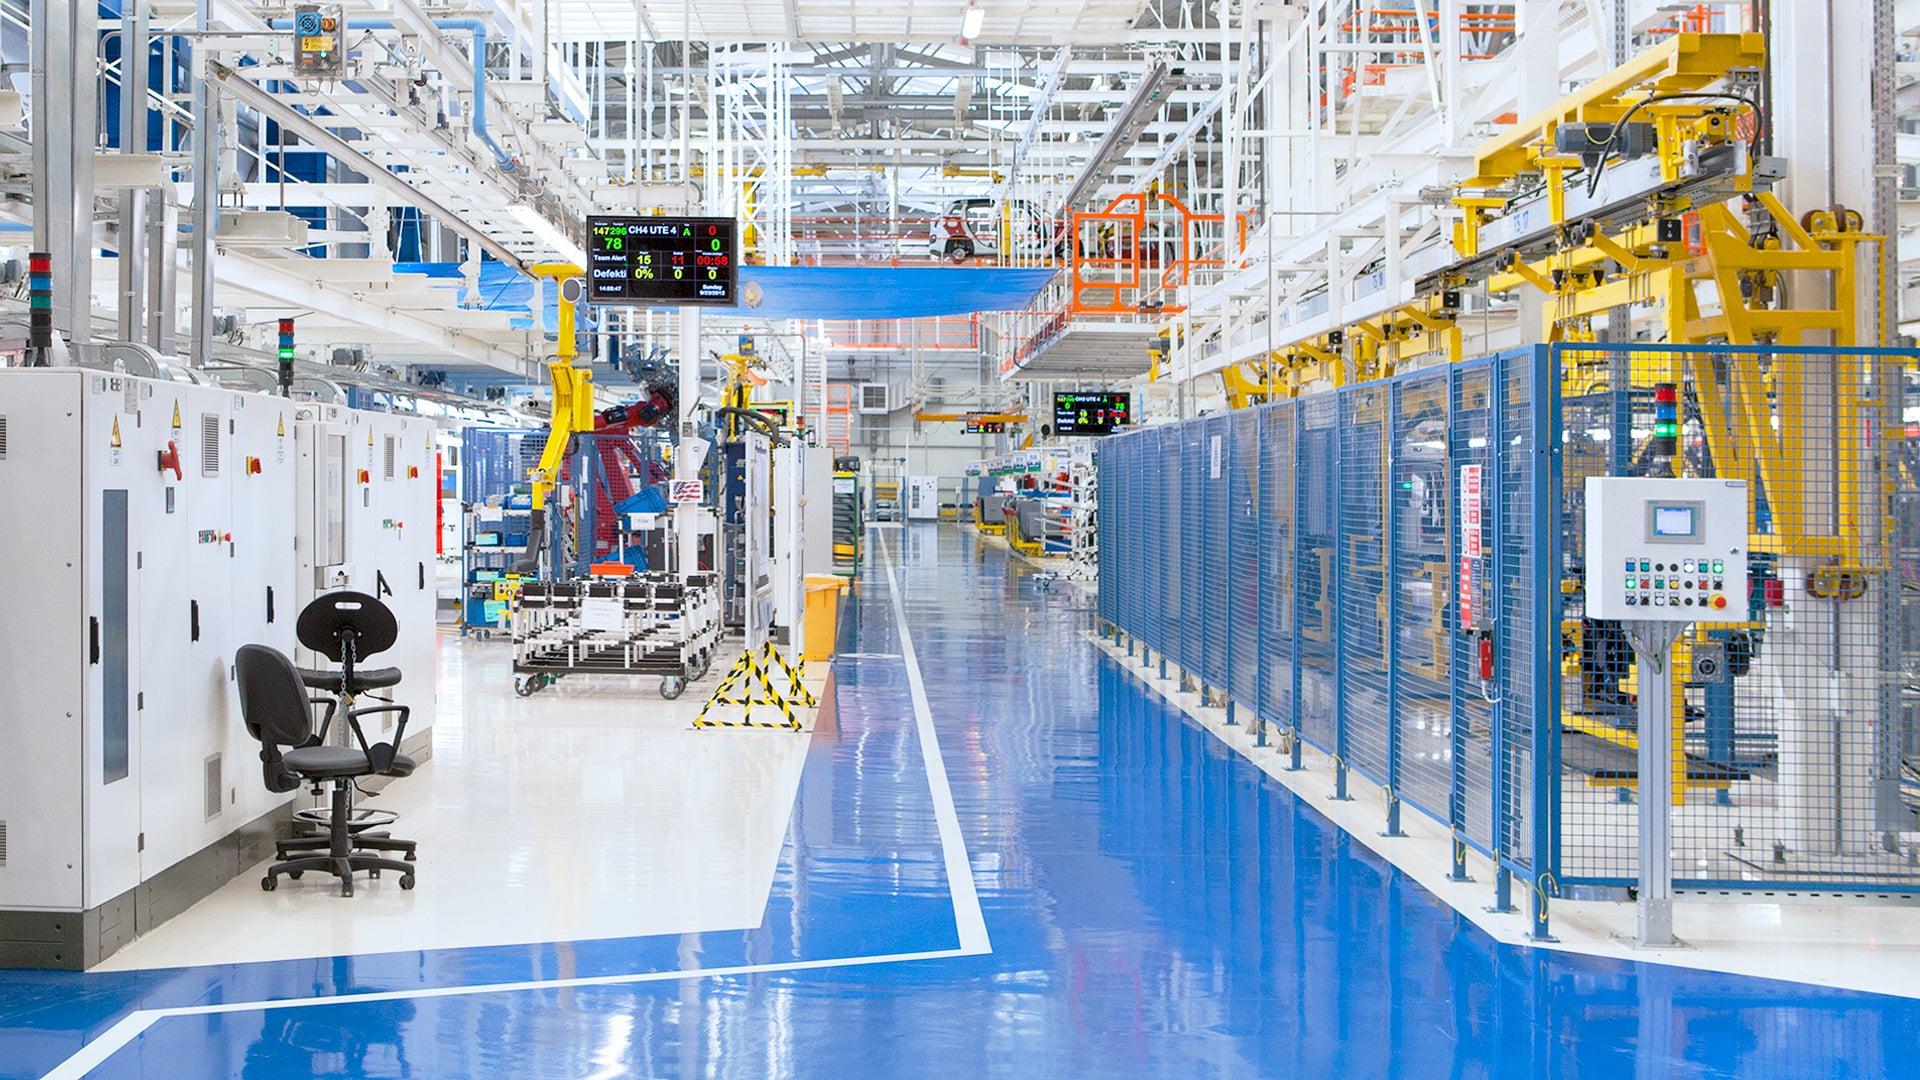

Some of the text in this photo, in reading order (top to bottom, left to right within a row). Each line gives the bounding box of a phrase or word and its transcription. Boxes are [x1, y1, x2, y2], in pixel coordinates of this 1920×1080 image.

[593, 227, 610, 236] 147
[610, 227, 628, 236] 296
[628, 225, 677, 235] CH4 UTE 4
[682, 227, 691, 236] A
[708, 225, 717, 236] 0
[604, 237, 622, 250] 78
[711, 239, 721, 251] 0
[637, 255, 651, 265] 15
[671, 255, 685, 265] 11
[593, 269, 627, 278] Defekti
[634, 268, 654, 279] 0%
[674, 269, 682, 279] 0
[708, 269, 717, 280] 0
